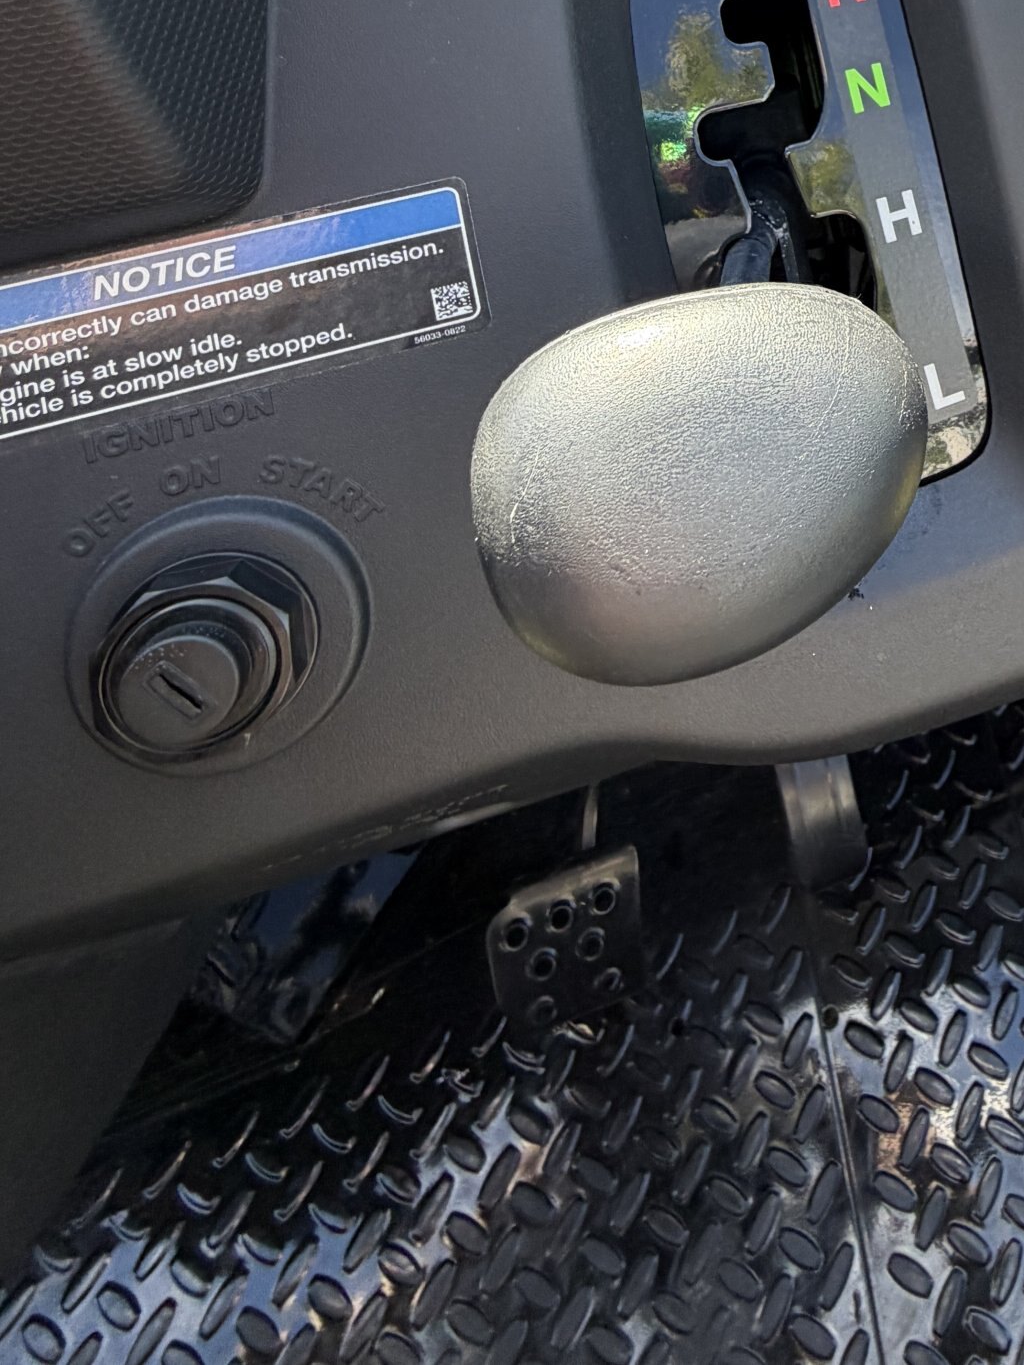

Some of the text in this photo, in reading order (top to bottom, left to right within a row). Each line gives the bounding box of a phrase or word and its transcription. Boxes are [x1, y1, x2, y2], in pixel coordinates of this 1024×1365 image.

[845, 62, 891, 114] N
[875, 189, 923, 244] H
[0, 242, 444, 358] ncorrectly can damage transmission.
[93, 245, 237, 301] NOTICE
[10, 346, 90, 376] when:
[414, 325, 466, 345] 56033-0822
[0, 333, 243, 407] gine is at slow idle.
[0, 323, 353, 424] hicle is completely stopped.
[923, 363, 967, 411] L
[81, 387, 276, 465] IGNITION
[160, 455, 222, 496] ON
[258, 454, 385, 523] START
[62, 488, 134, 558] OFF
